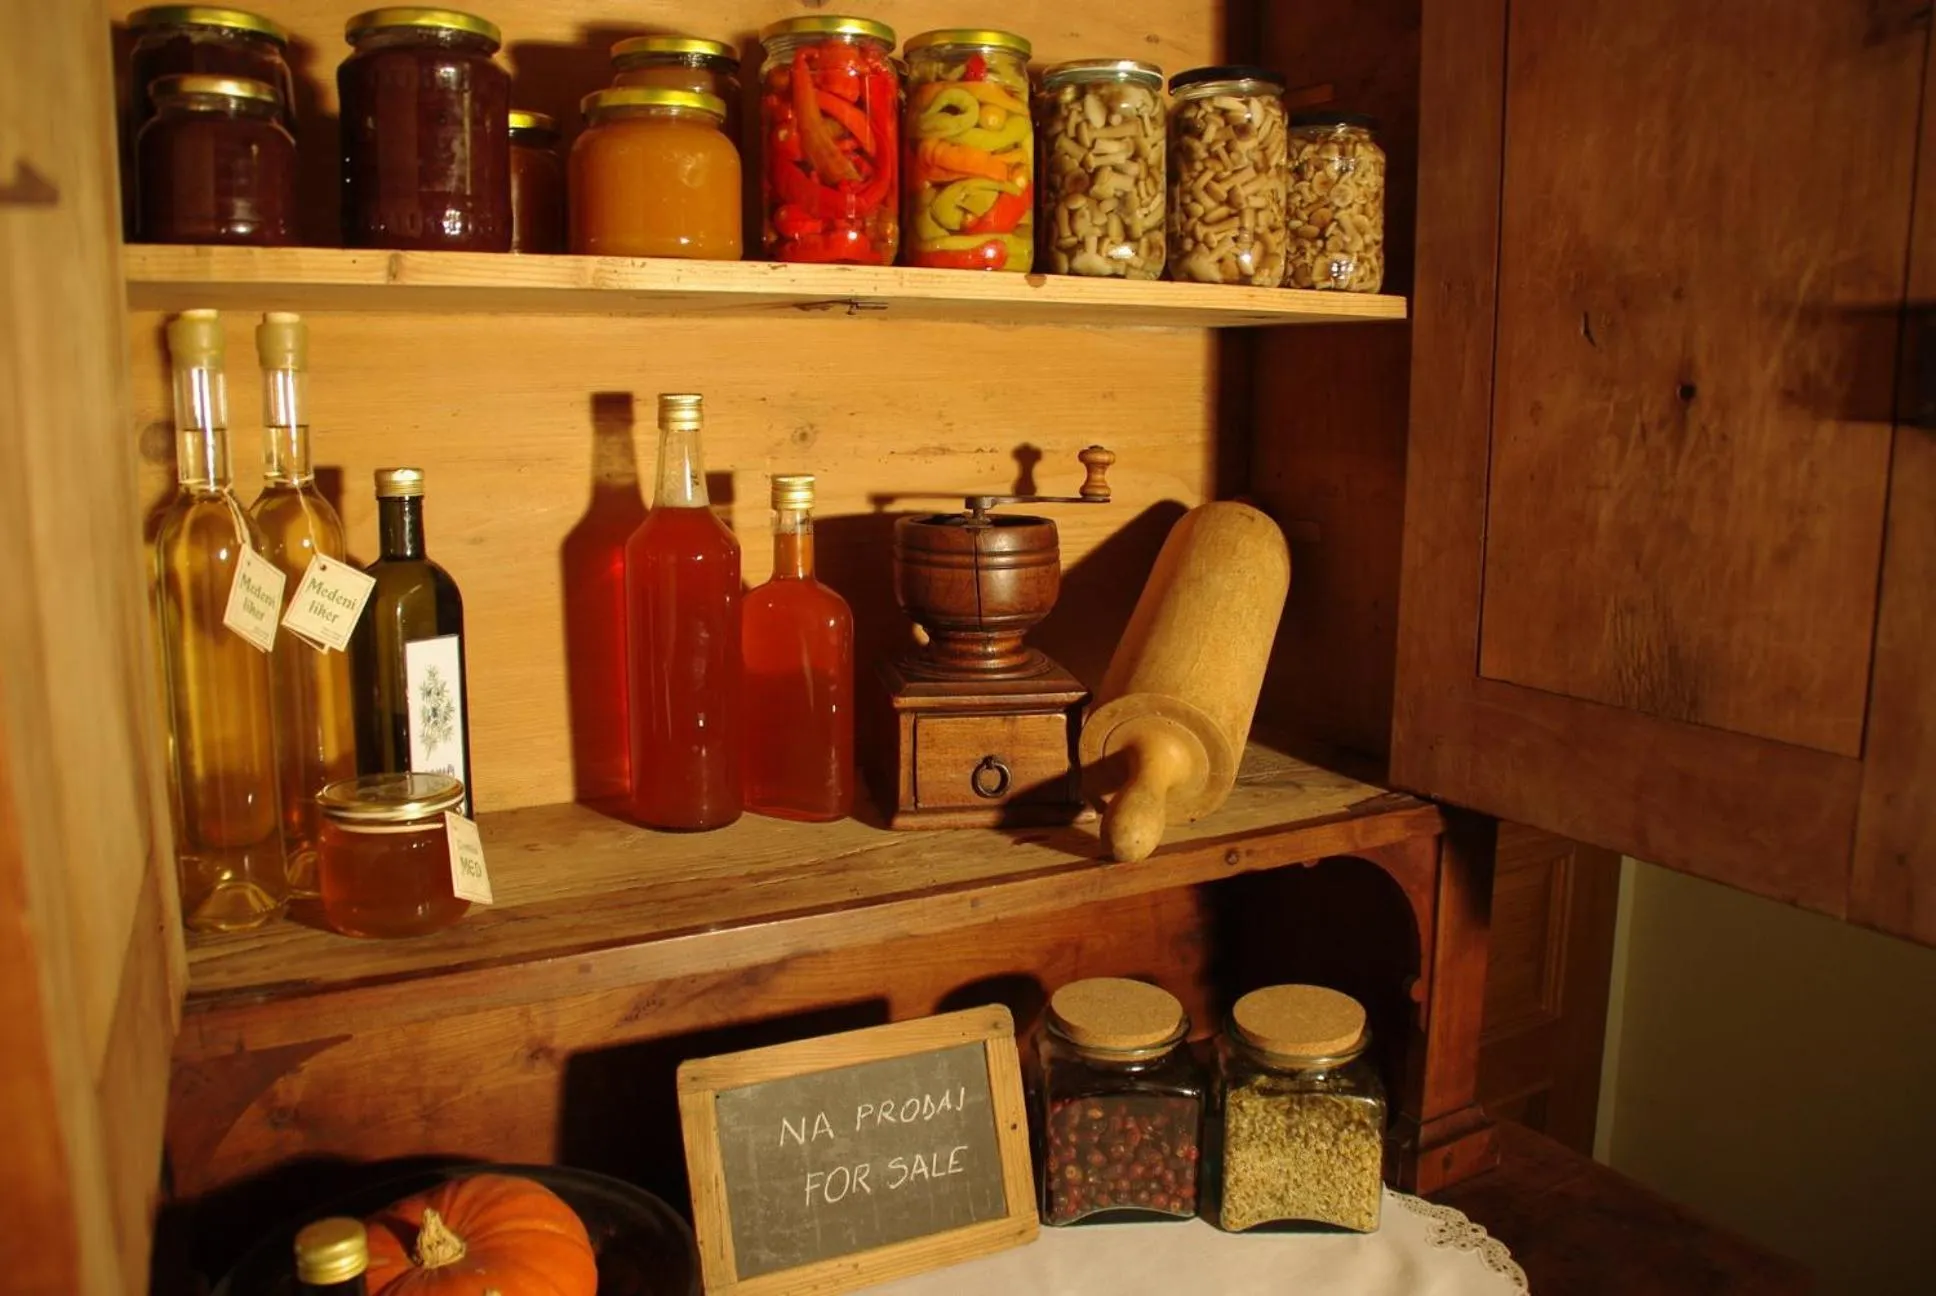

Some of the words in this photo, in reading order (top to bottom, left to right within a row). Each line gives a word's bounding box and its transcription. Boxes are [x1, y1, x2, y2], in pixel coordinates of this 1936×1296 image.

[305, 577, 358, 611] Medeni
[460, 856, 482, 878] MED
[779, 1111, 835, 1147] NA
[856, 1086, 966, 1132] PRODAJ
[804, 1163, 872, 1207] FOR
[886, 1145, 969, 1190] SALE
